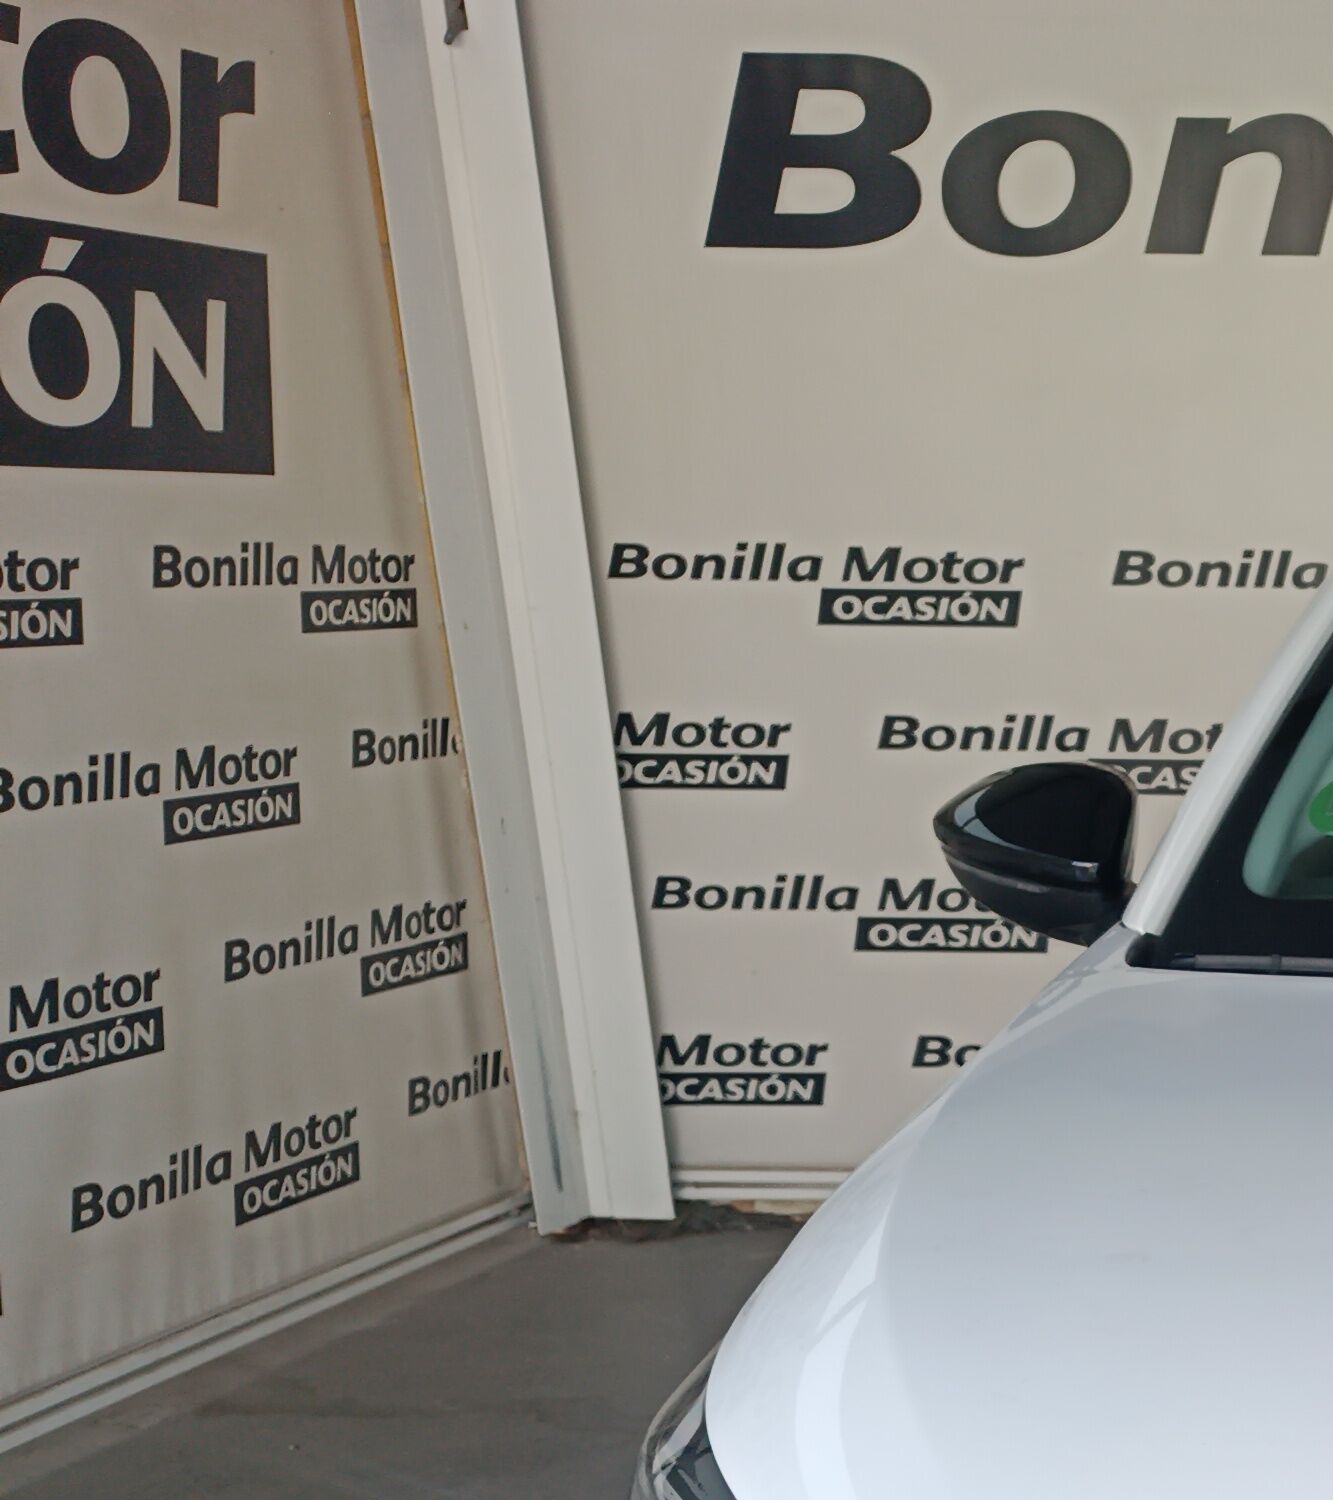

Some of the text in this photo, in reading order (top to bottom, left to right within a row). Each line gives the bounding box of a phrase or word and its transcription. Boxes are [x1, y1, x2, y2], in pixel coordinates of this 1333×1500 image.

[0, 3, 255, 208] or
[0, 550, 79, 592] tor
[153, 542, 415, 588] Bonilla Motor
[607, 543, 1025, 584] Bonilla Motor
[1112, 549, 1328, 588] Bonilla
[310, 592, 410, 625] OCASIÓN
[832, 592, 1009, 621] OCASIÓN
[614, 711, 792, 748] Motor
[878, 714, 1223, 753] Bonilla Mot
[175, 745, 297, 791] Motor
[173, 789, 292, 836] OCASIÓN
[651, 875, 859, 912] Bonilla
[224, 899, 466, 983] Bonilla Motor
[868, 918, 1037, 948] OCASIÓN
[369, 941, 463, 988] OCASIÓN
[9, 968, 160, 1032] Motor
[6, 1018, 154, 1080] OCASIÓN
[658, 1034, 829, 1067] Motor
[409, 1050, 509, 1116] Bonill
[72, 1107, 356, 1232] Bonilla Motor
[243, 1154, 353, 1215] OCASIÓN
